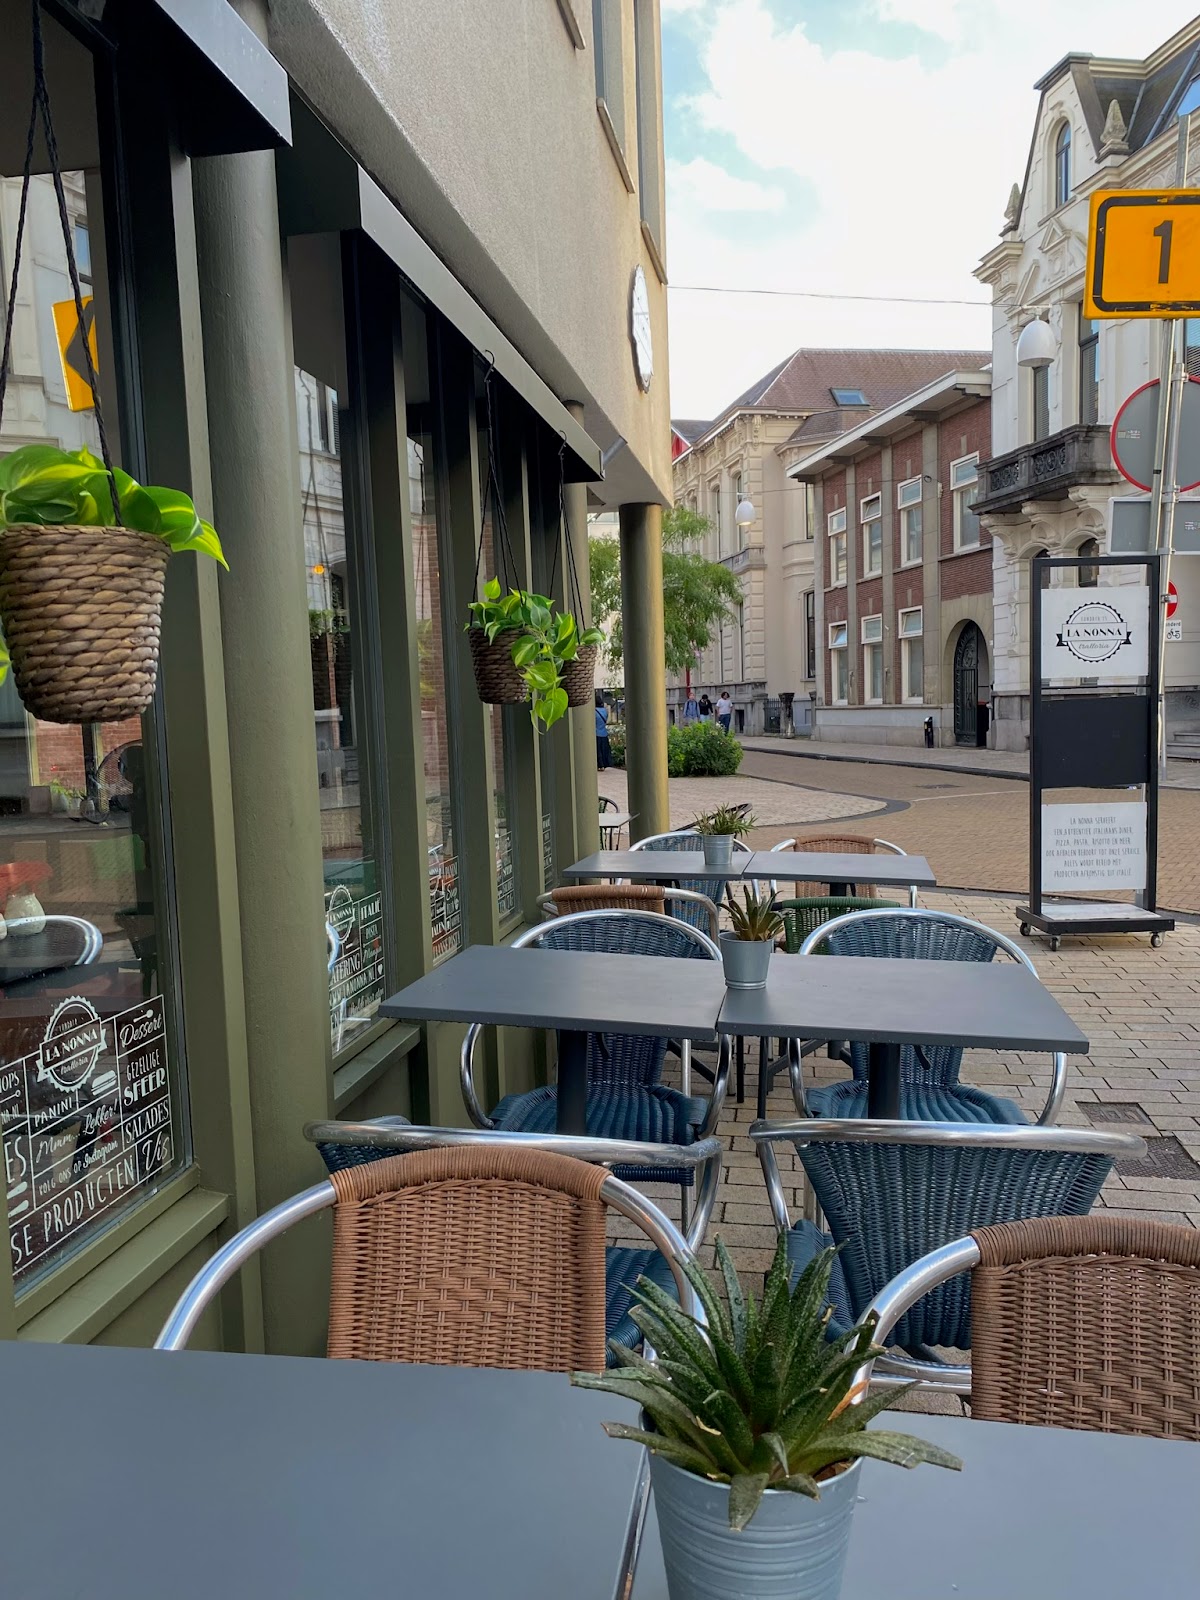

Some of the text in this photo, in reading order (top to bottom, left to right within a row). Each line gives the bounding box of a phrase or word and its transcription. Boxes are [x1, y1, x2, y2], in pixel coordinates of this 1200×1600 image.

[1153, 220, 1173, 284] 1
[1067, 628, 1122, 637] LA NONNA
[1070, 816, 1116, 825] LA NONNA SERVEERT
[1093, 827, 1118, 835] ITALIAANS
[1056, 849, 1077, 857] AFHALEN
[1098, 848, 1107, 856] TOT
[1108, 848, 1120, 856] ONZE
[1080, 859, 1094, 867] WORDT
[1112, 858, 1121, 866] MET
[1053, 870, 1079, 878] PRODUCTEN
[45, 1028, 98, 1062] LA NONNA
[120, 1013, 162, 1048] Dessert
[60, 1056, 89, 1075] trattoria
[127, 1048, 160, 1082] GEZELLIGE
[124, 1067, 166, 1107] SFEER
[34, 1097, 73, 1128] PANINI
[83, 1098, 118, 1135] Lekker!
[125, 1099, 169, 1144] SALADES
[39, 1140, 119, 1196] VOLG ONS OP Instagram
[142, 1131, 170, 1172] Vis
[43, 1154, 137, 1243] PRODUCTEN
